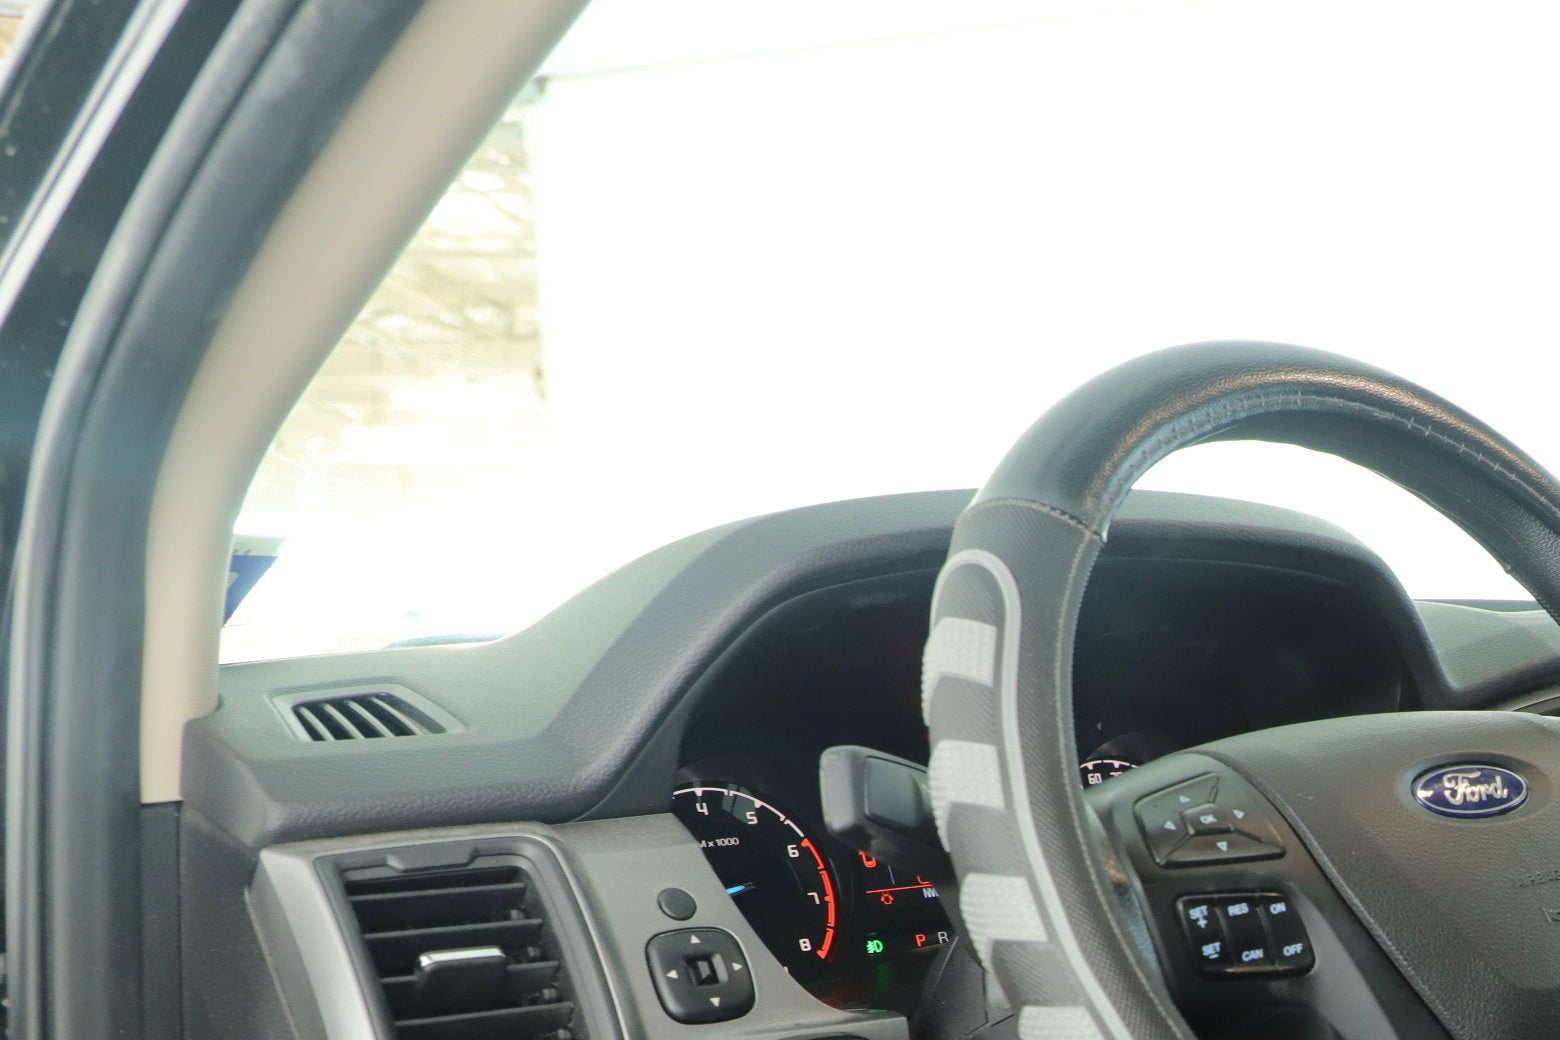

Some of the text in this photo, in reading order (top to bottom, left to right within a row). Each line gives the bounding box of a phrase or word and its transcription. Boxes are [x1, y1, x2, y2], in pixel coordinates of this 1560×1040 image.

[1087, 773, 1103, 785] 60
[1442, 771, 1508, 805] Ford
[695, 802, 709, 816] 4
[745, 811, 758, 825] 5
[786, 844, 800, 858] 6
[807, 892, 820, 904] 7
[1188, 905, 1208, 920] SET
[1227, 903, 1249, 916] RES
[1269, 902, 1287, 915] ON
[799, 938, 812, 951] 8
[915, 930, 949, 947] P R
[1201, 942, 1221, 956] SET
[1241, 948, 1264, 962] CAN
[1282, 943, 1303, 957] OFF
